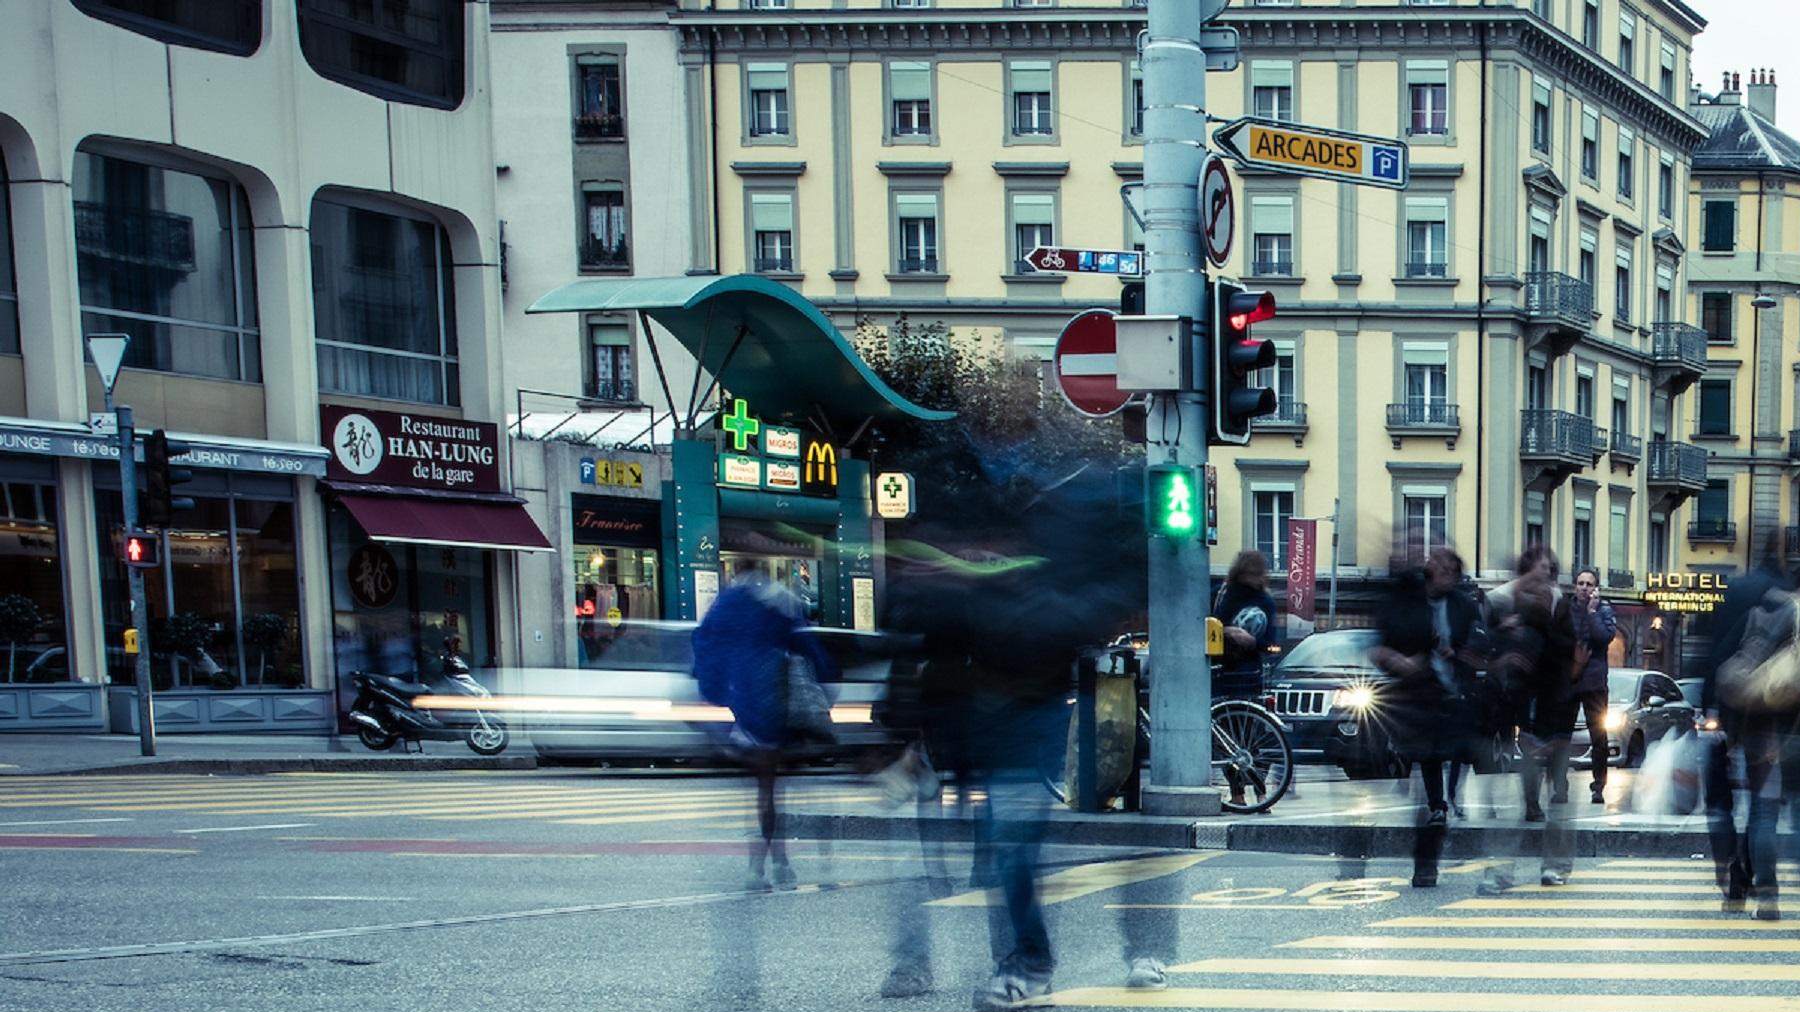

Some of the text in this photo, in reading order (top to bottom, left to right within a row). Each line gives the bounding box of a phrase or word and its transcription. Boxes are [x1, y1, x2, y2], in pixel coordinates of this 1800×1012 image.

[1256, 131, 1357, 168] ARCADES
[1119, 260, 1137, 274] 50
[400, 416, 481, 441] Restaurant
[388, 437, 494, 465] HAN-LUNG
[768, 439, 798, 451] MIGROS
[413, 461, 474, 485] de la gare
[1648, 572, 1728, 589] HOTEL
[1645, 592, 1725, 603] INTERNATIONAL
[1658, 602, 1714, 612] TERMINUS
